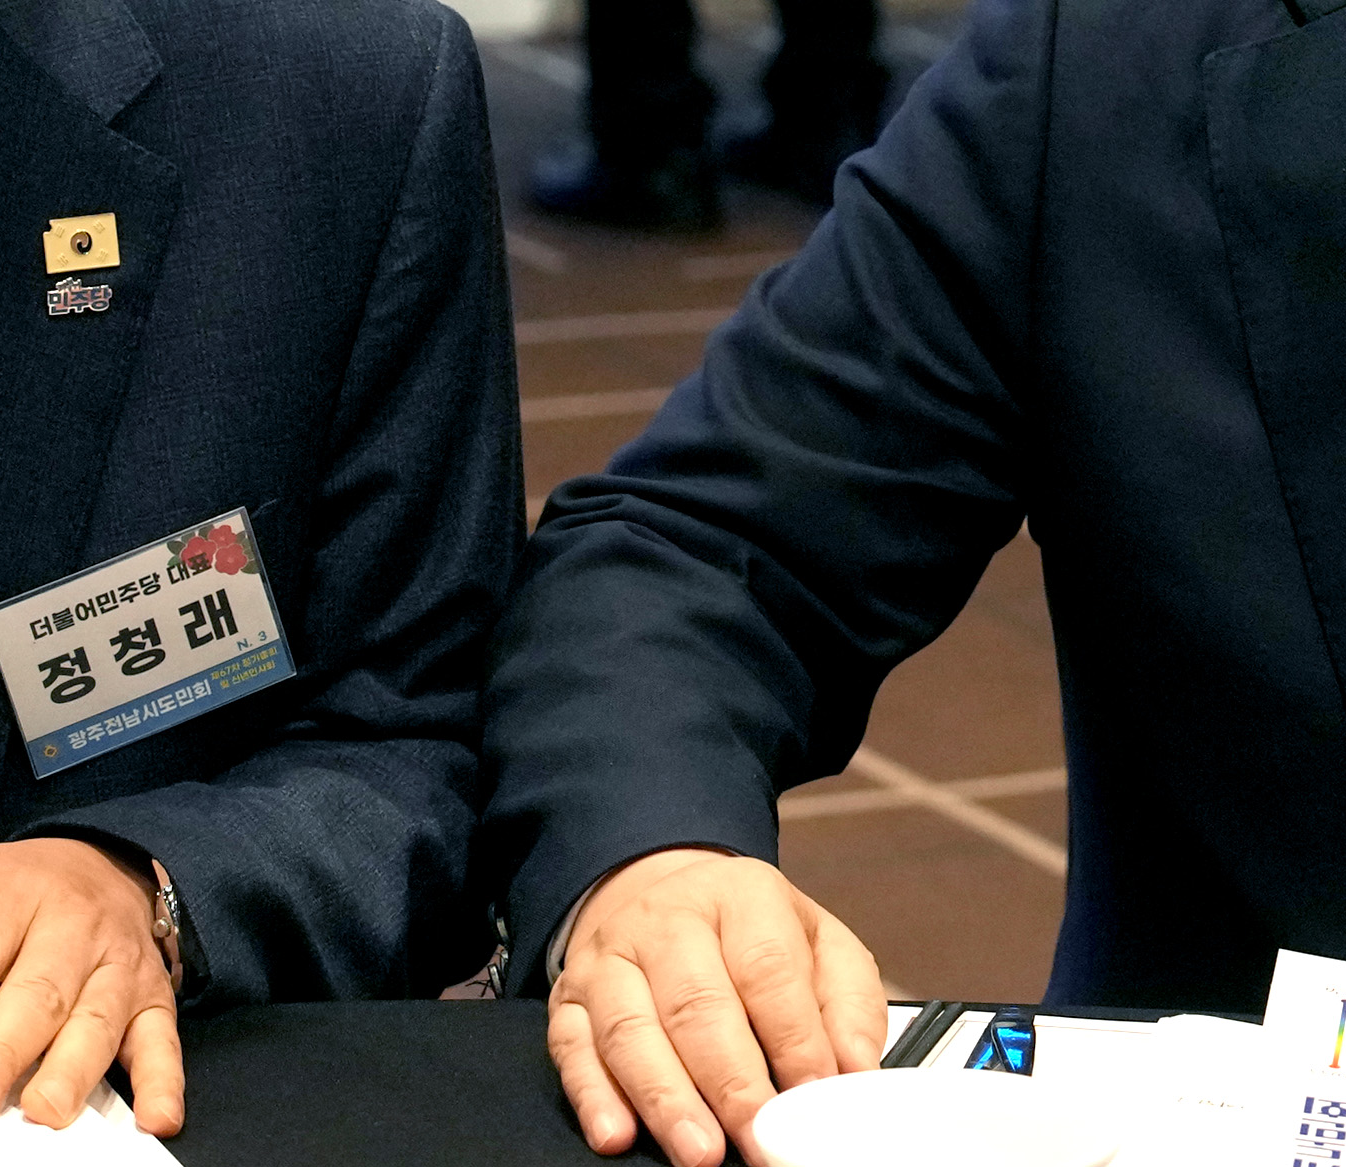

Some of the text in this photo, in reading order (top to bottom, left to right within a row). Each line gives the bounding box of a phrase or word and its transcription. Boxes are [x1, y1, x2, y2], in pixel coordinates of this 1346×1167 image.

[47, 284, 113, 315] 민주당
[29, 552, 213, 640] 더불어민주당 대표
[67, 679, 212, 750] 광주전남시도민회
